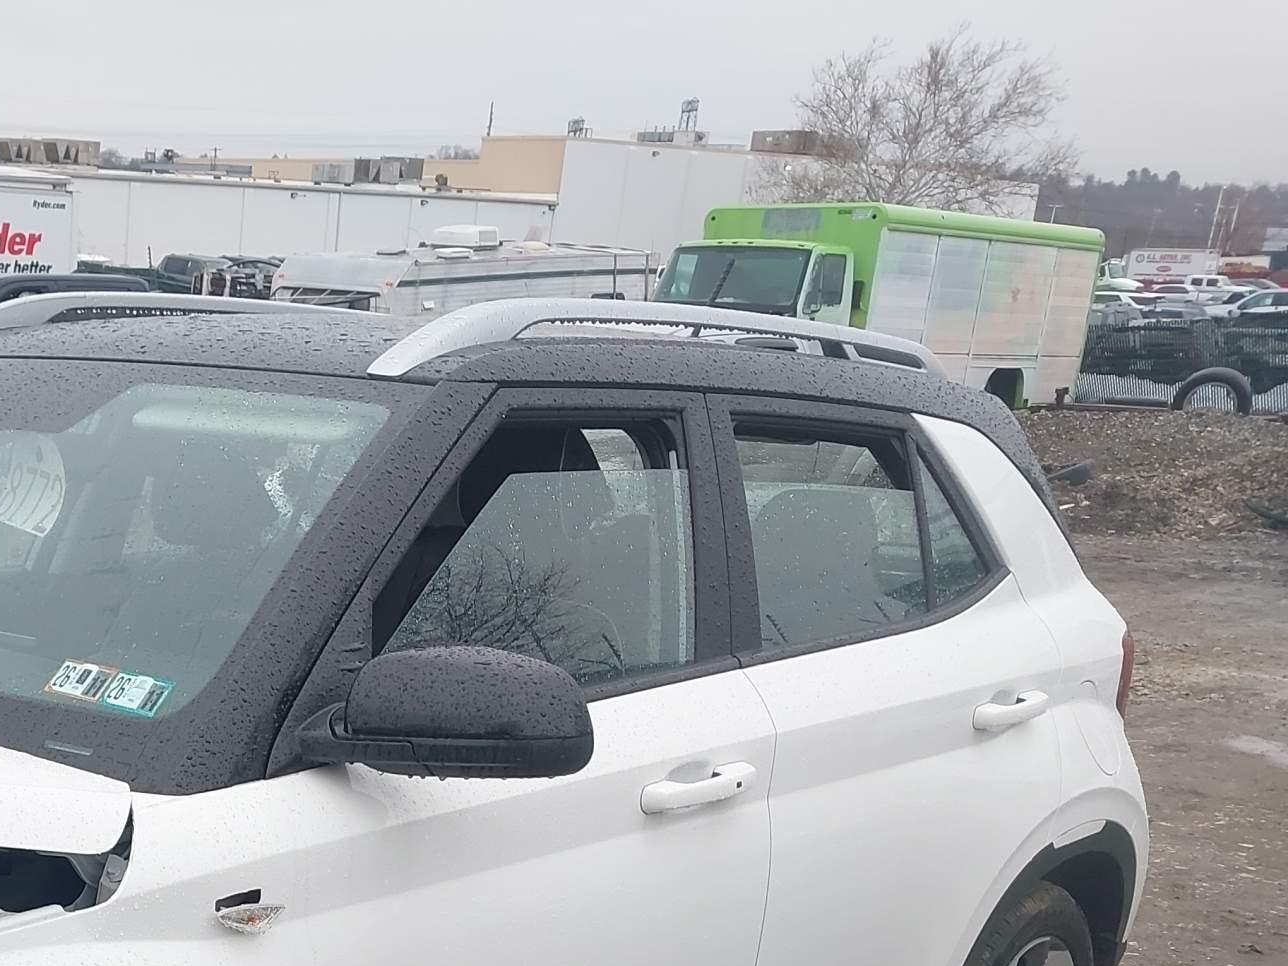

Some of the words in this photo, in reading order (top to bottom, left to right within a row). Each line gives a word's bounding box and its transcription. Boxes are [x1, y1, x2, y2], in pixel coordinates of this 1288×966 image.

[33, 199, 66, 210] Ryder.com
[52, 664, 78, 688] 26
[107, 676, 132, 700] 26
